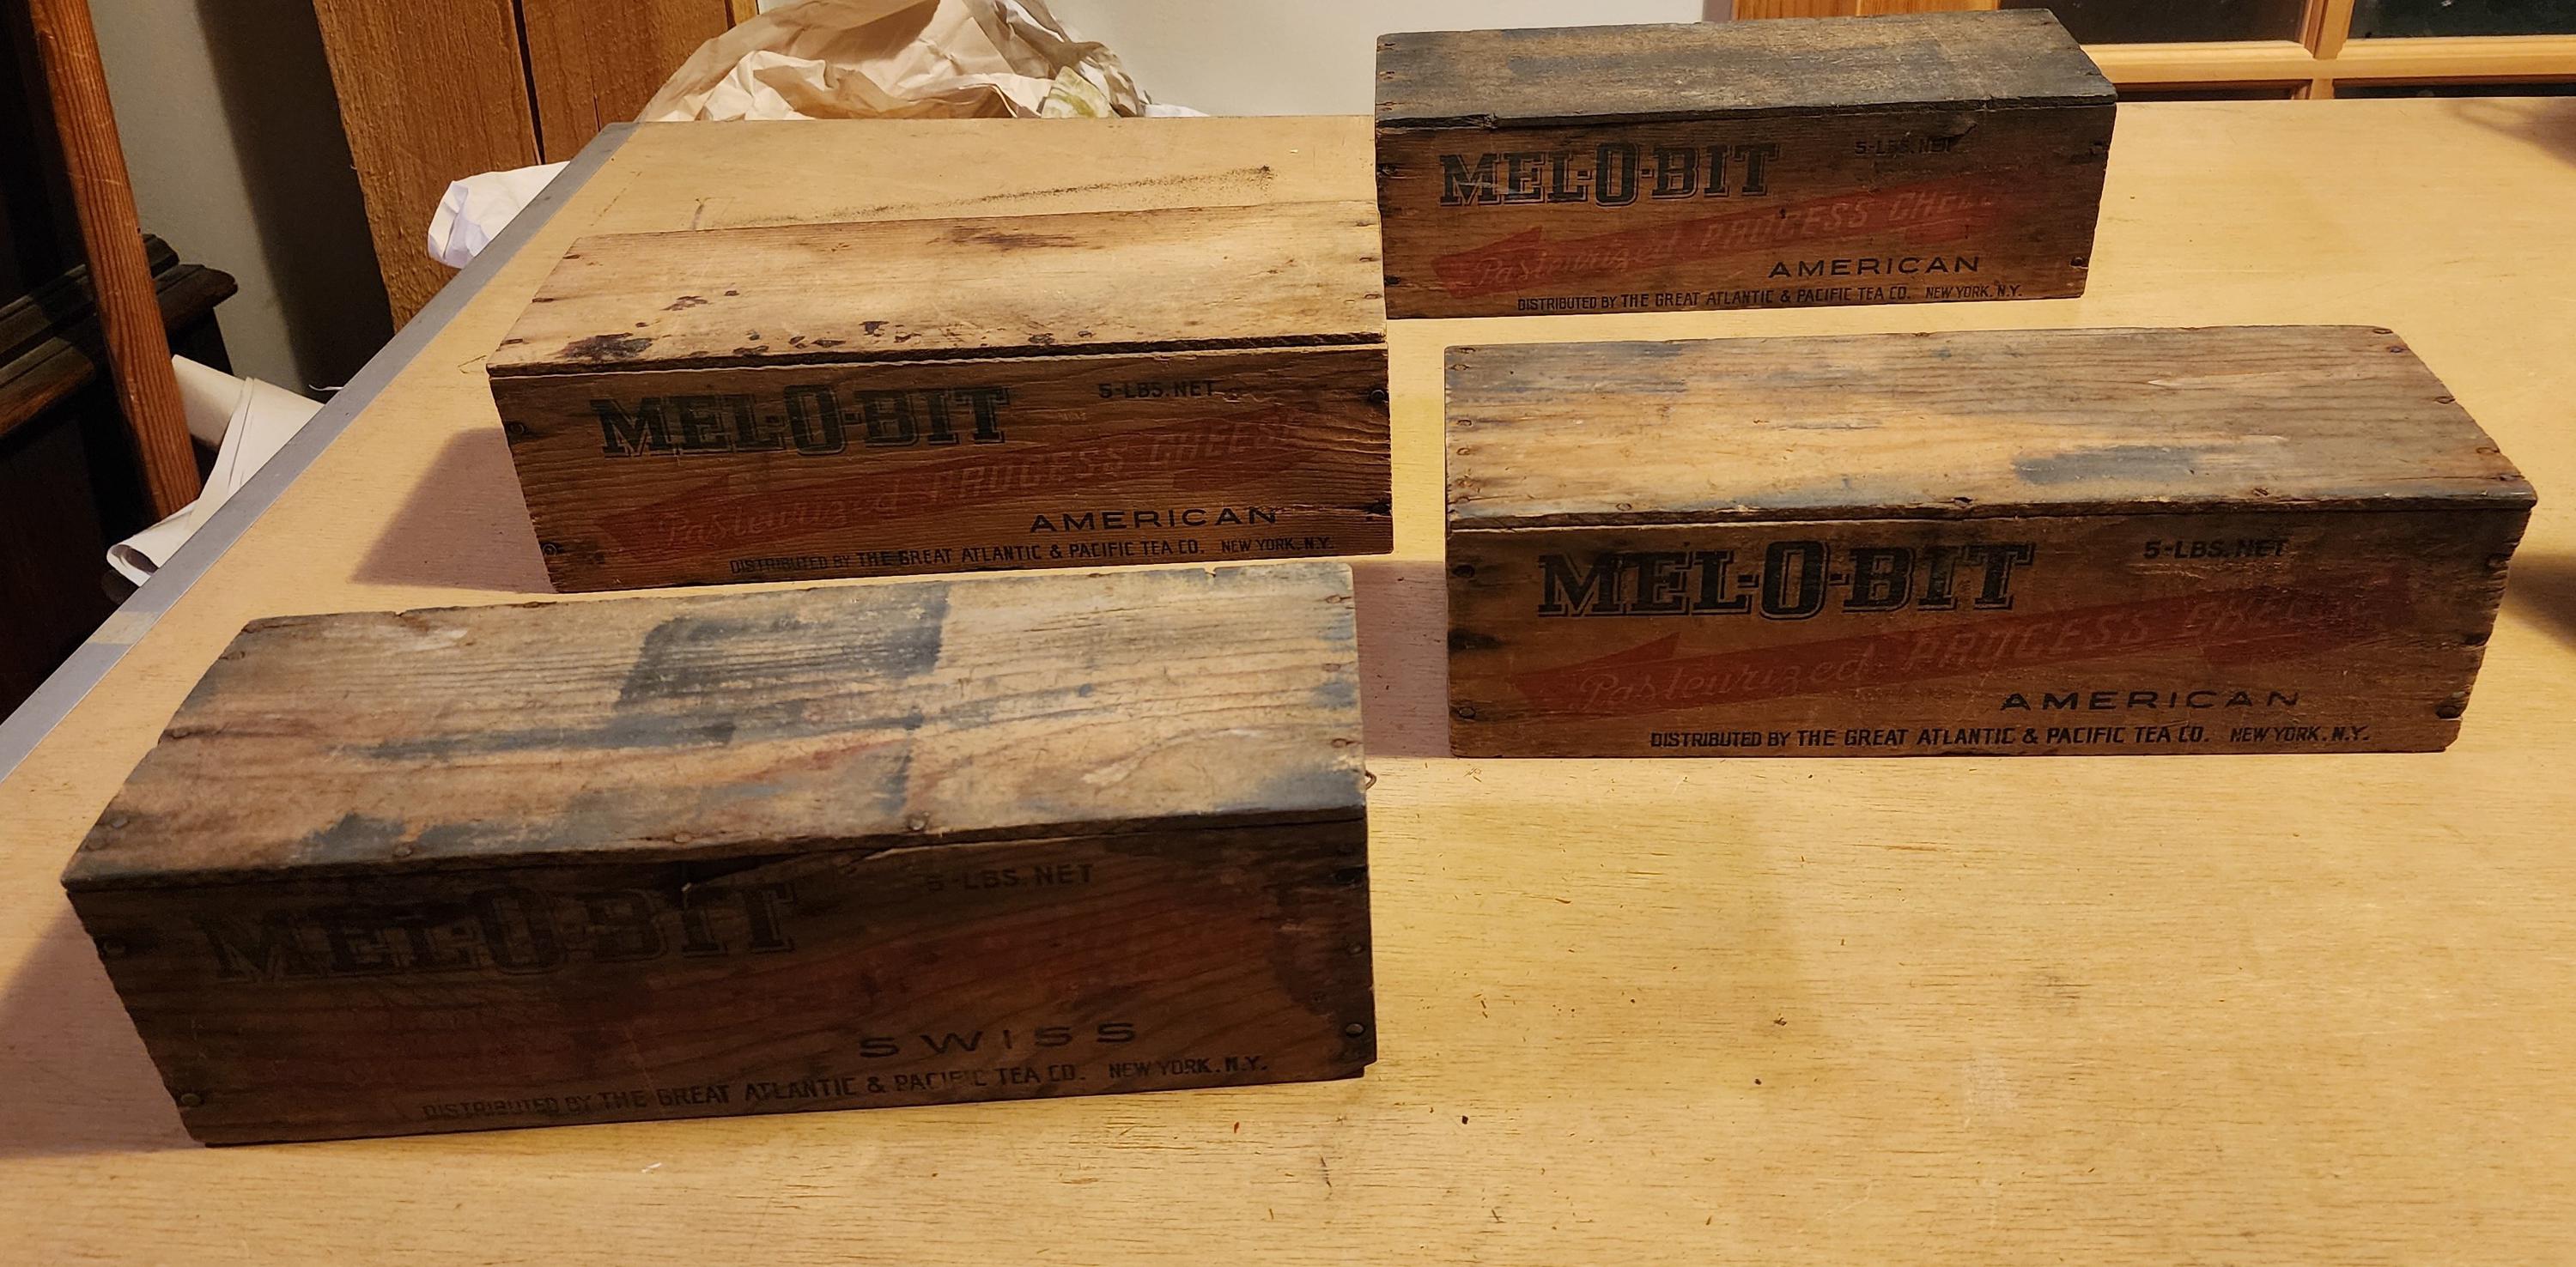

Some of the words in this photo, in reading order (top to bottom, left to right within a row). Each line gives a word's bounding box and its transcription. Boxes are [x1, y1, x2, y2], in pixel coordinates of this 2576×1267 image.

[1438, 142, 1781, 207] MEL-O-BIT
[1769, 257, 1979, 278] AMERICAN
[1518, 295, 1596, 312] DISTRIBUTED
[1601, 295, 1618, 309] BY
[1621, 294, 1649, 308] THE
[1656, 292, 1700, 307] GREAT
[1707, 288, 1772, 306] ATLANTIC
[1779, 288, 1791, 301] &
[1797, 287, 1851, 301] PACIFIC
[1858, 286, 1884, 300] TEA
[1890, 285, 1911, 300] CO.
[1926, 286, 1953, 299] NEW
[590, 385, 1011, 459] MEL-O-BIT
[1030, 507, 1277, 533] AMERICAN
[731, 556, 828, 573] DISTRIBUTED
[834, 555, 850, 569] BY
[856, 552, 894, 567] THE
[899, 549, 951, 566] GREAT
[962, 543, 1042, 562] ATLANTIC
[1050, 543, 1062, 558] &
[1069, 541, 1134, 558] PACIFIC
[1141, 540, 1174, 556] TEA
[1179, 538, 1205, 555] CO.
[1221, 539, 1252, 553] NEW
[1538, 541, 2036, 621] MEL-O-BIT
[1568, 643, 1875, 711] Pasteurized
[1903, 609, 2159, 670] PROCESS
[2000, 689, 2300, 711] AMERICAN
[1650, 731, 1762, 748] DISTRIBUTED
[1767, 730, 1791, 748] BY
[1797, 730, 1836, 746] THE
[1844, 729, 1908, 746] GREAT
[1916, 727, 2016, 745] ATLANTIC
[2022, 728, 2038, 744] &
[2046, 726, 2125, 743] PACIFIC
[2134, 725, 2172, 743] TEA
[2178, 725, 2209, 743] CO.
[2230, 727, 2269, 742] NEW
[860, 1022, 1138, 1058] SWISS
[565, 1094, 592, 1114] BY
[598, 1089, 647, 1110] THE
[656, 1082, 730, 1107] GREAT
[744, 1076, 856, 1100] ATLANTIC
[867, 1076, 885, 1094] &
[996, 1066, 1041, 1086] TEA
[1048, 1064, 1086, 1082] CO.
[1109, 1061, 1151, 1078] NEW
